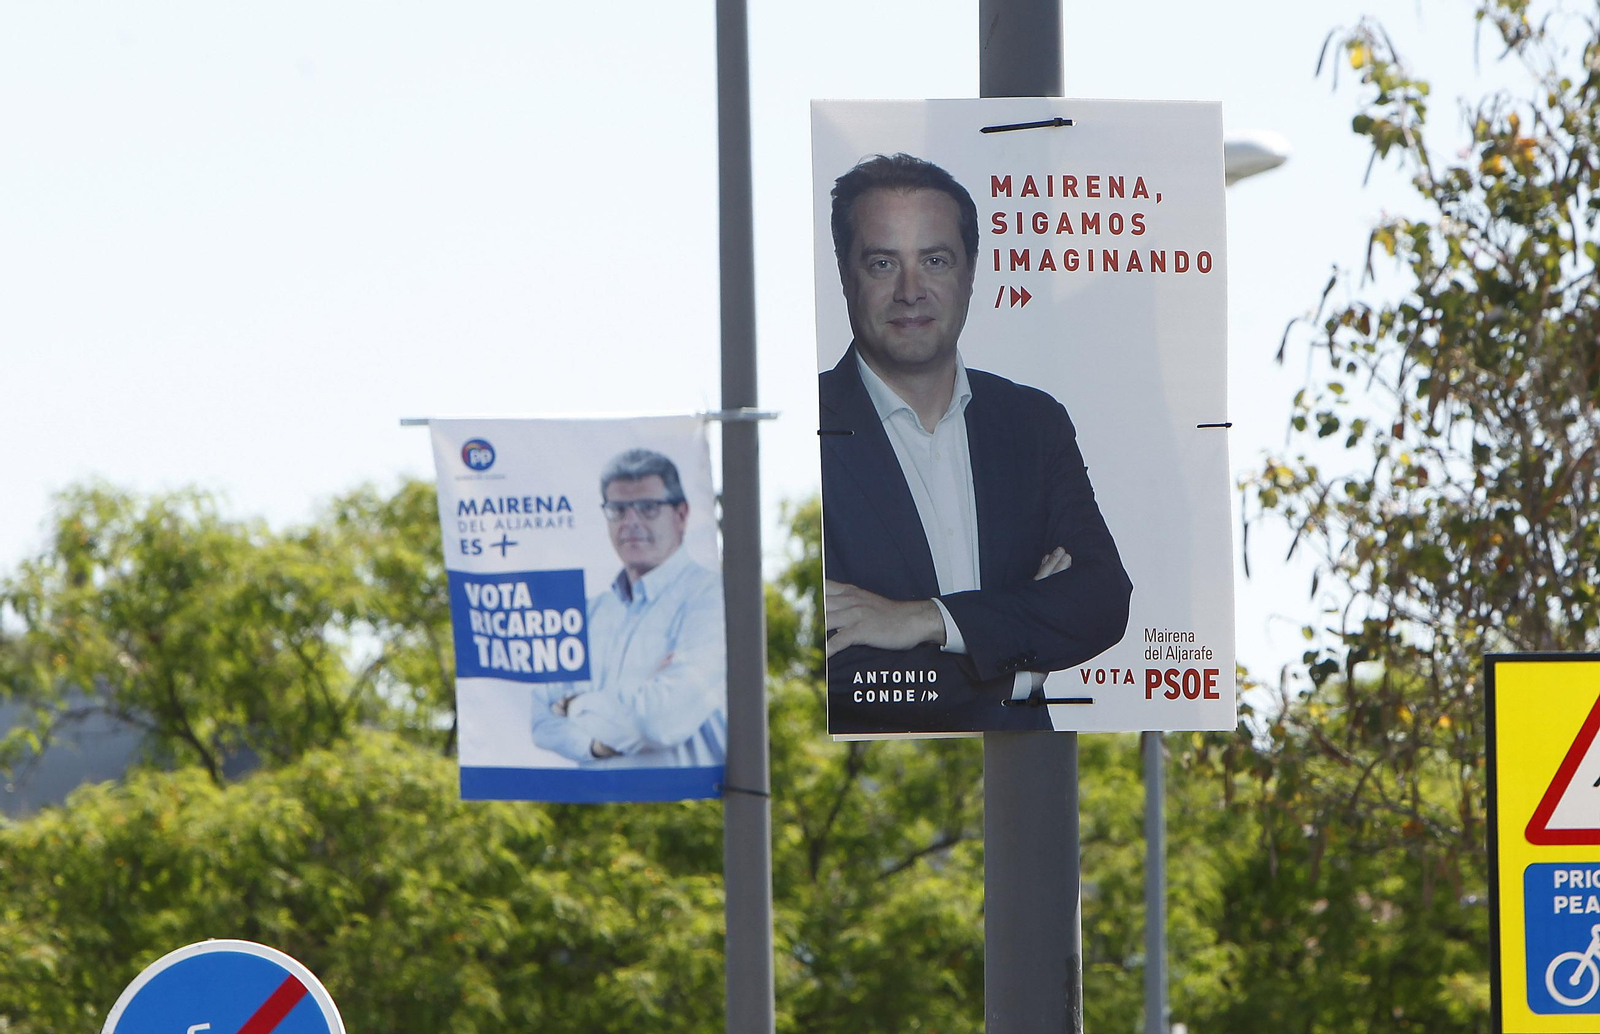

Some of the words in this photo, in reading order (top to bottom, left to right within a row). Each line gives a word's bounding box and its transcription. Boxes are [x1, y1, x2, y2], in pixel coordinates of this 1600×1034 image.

[990, 174, 1162, 204] MAIRENA,
[991, 211, 1146, 236] SIGAMOS
[993, 248, 1212, 274] IMAGINANDO
[457, 495, 572, 517] MAIRENA
[457, 519, 486, 534] DEL
[494, 515, 576, 531] ALJARAFE
[460, 538, 483, 556] ES
[464, 581, 533, 610] VOTA
[468, 607, 584, 638] RICARDO
[1144, 627, 1195, 643] Mairena
[473, 636, 586, 674] TARNO
[1144, 646, 1163, 660] del
[1165, 645, 1213, 664] Aljarafe
[852, 670, 938, 684] ANTONIO
[1079, 668, 1136, 685] VOTA
[1144, 668, 1220, 700] PSOE
[853, 689, 916, 703] CONDE
